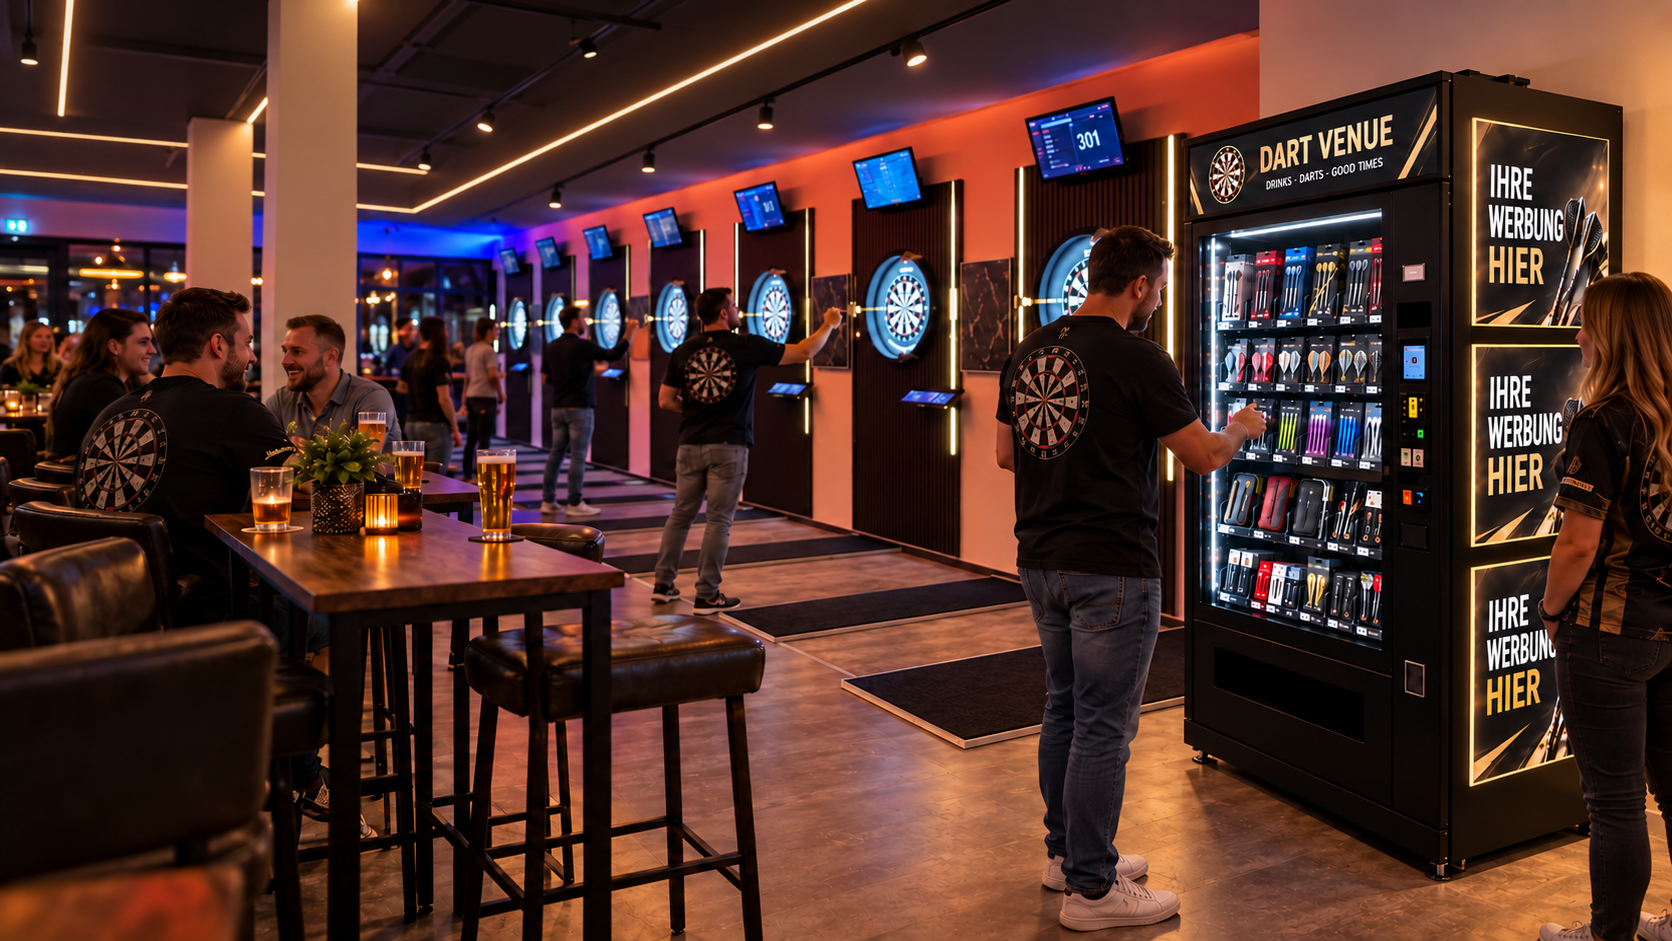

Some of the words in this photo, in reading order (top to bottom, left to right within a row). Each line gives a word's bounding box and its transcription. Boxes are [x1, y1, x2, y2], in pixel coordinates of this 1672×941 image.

[1077, 129, 1100, 150] 301
[1260, 134, 1313, 174] DART
[1318, 114, 1394, 160] VENUE
[1266, 176, 1292, 190] DRINKS
[1299, 169, 1324, 184] DARTS
[1331, 162, 1356, 177] GOOD
[1358, 157, 1384, 171] TIMES
[1490, 164, 1533, 200] IHRE
[1488, 204, 1564, 242] WERBUNG
[1488, 245, 1544, 285] HIER
[1489, 375, 1532, 410] IHRE
[1487, 412, 1563, 450] WERBUNG
[1487, 452, 1544, 496] HIER
[1488, 594, 1529, 633] IHRE
[1486, 668, 1541, 716] HIER
